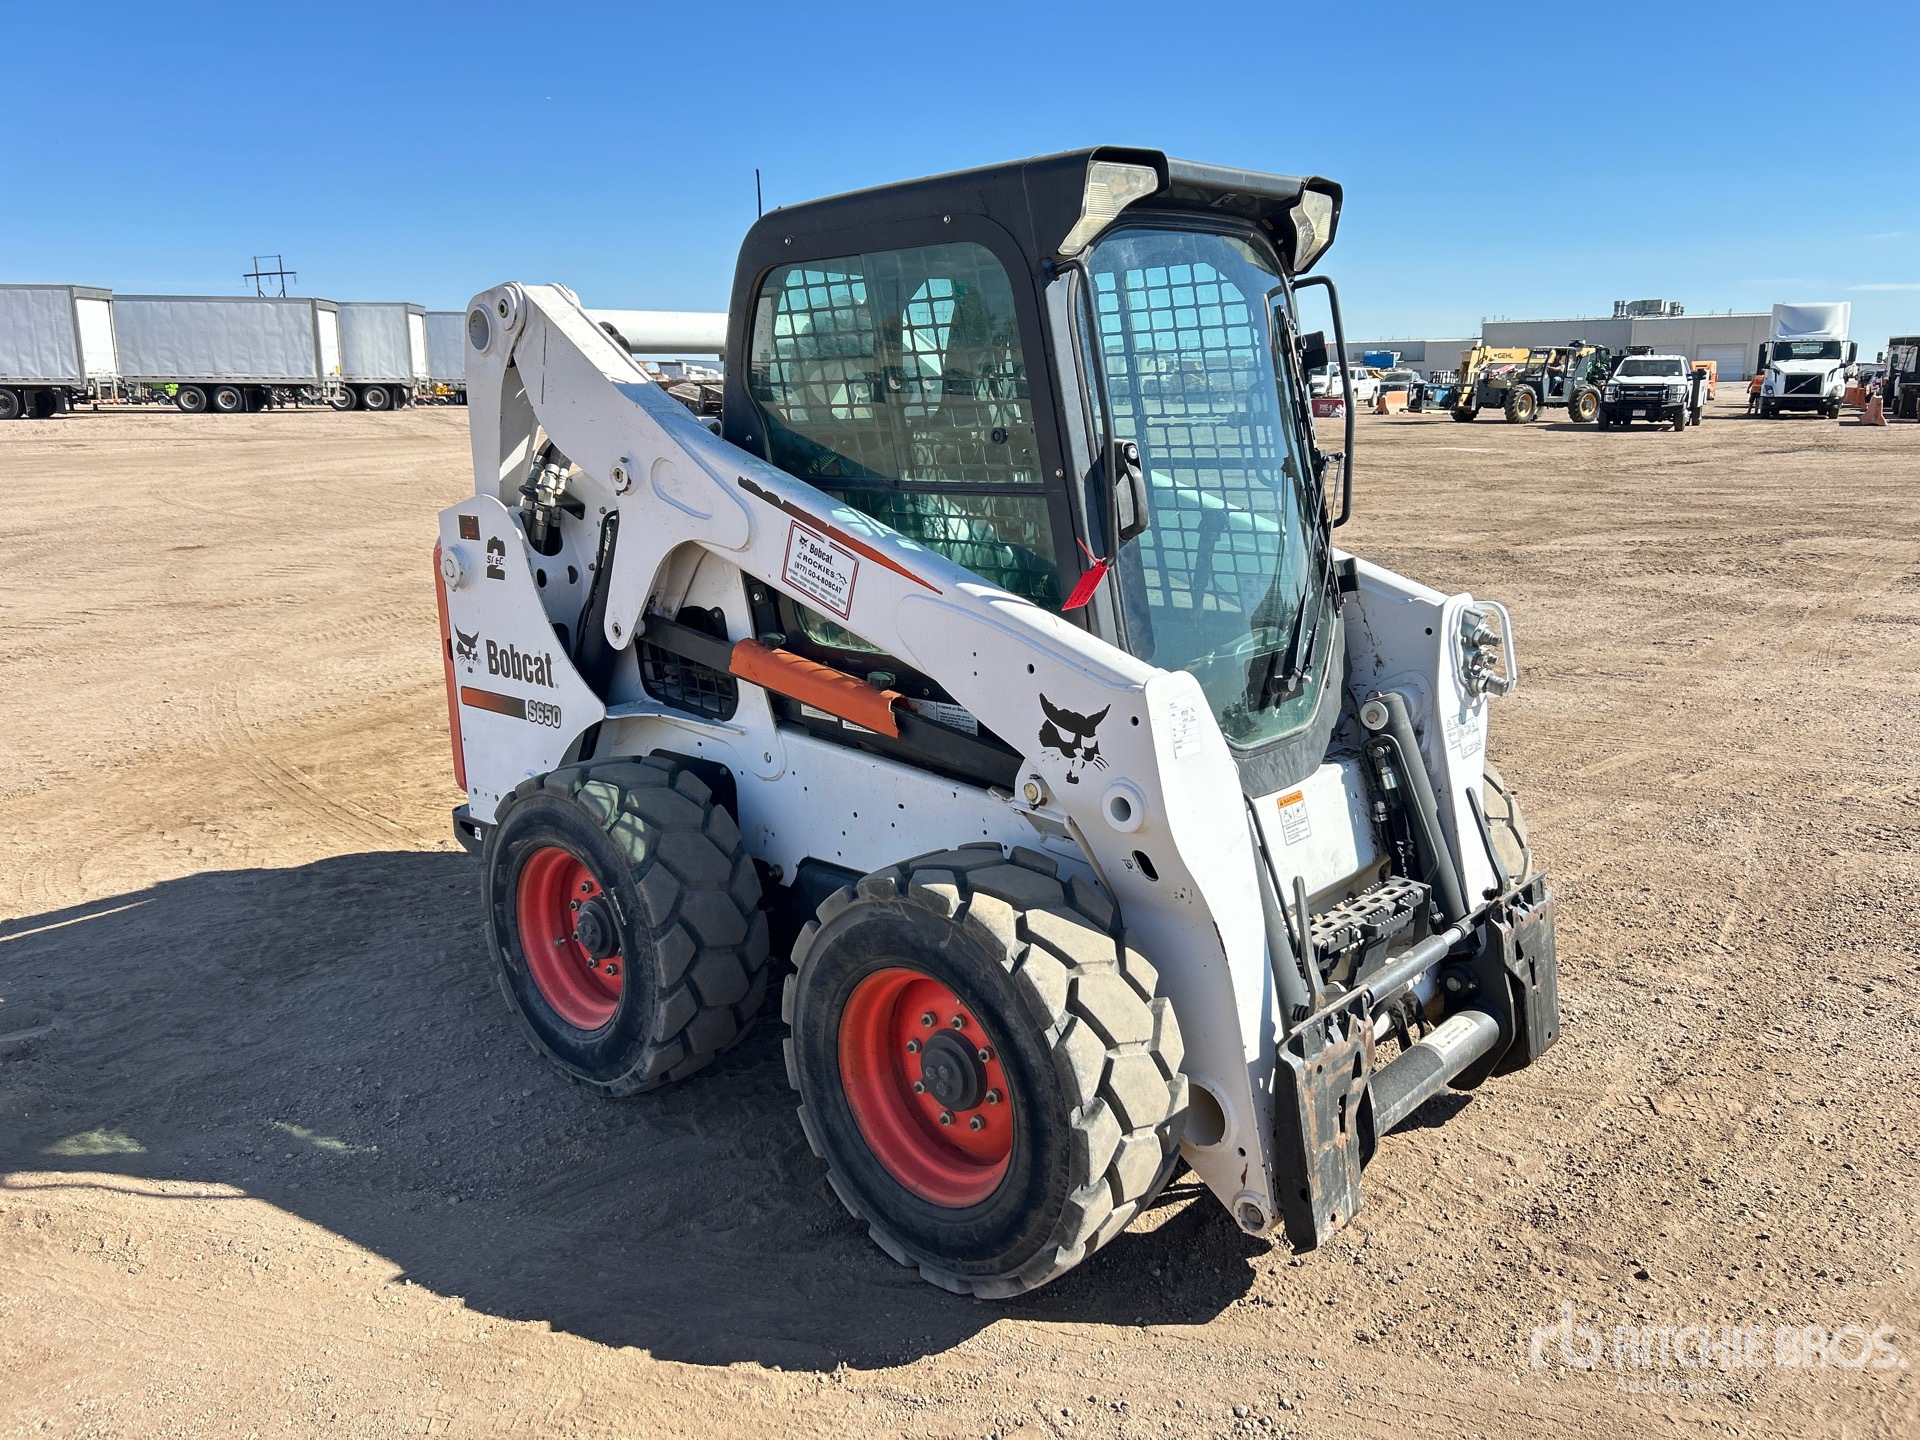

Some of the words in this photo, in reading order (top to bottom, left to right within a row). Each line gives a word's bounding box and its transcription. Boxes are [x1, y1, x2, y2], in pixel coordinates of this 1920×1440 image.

[809, 542, 833, 565] Bobcat
[794, 561, 808, 574] (877)
[802, 554, 836, 578] ROCKIES
[485, 639, 554, 688] Bobcat
[527, 699, 562, 729] S650
